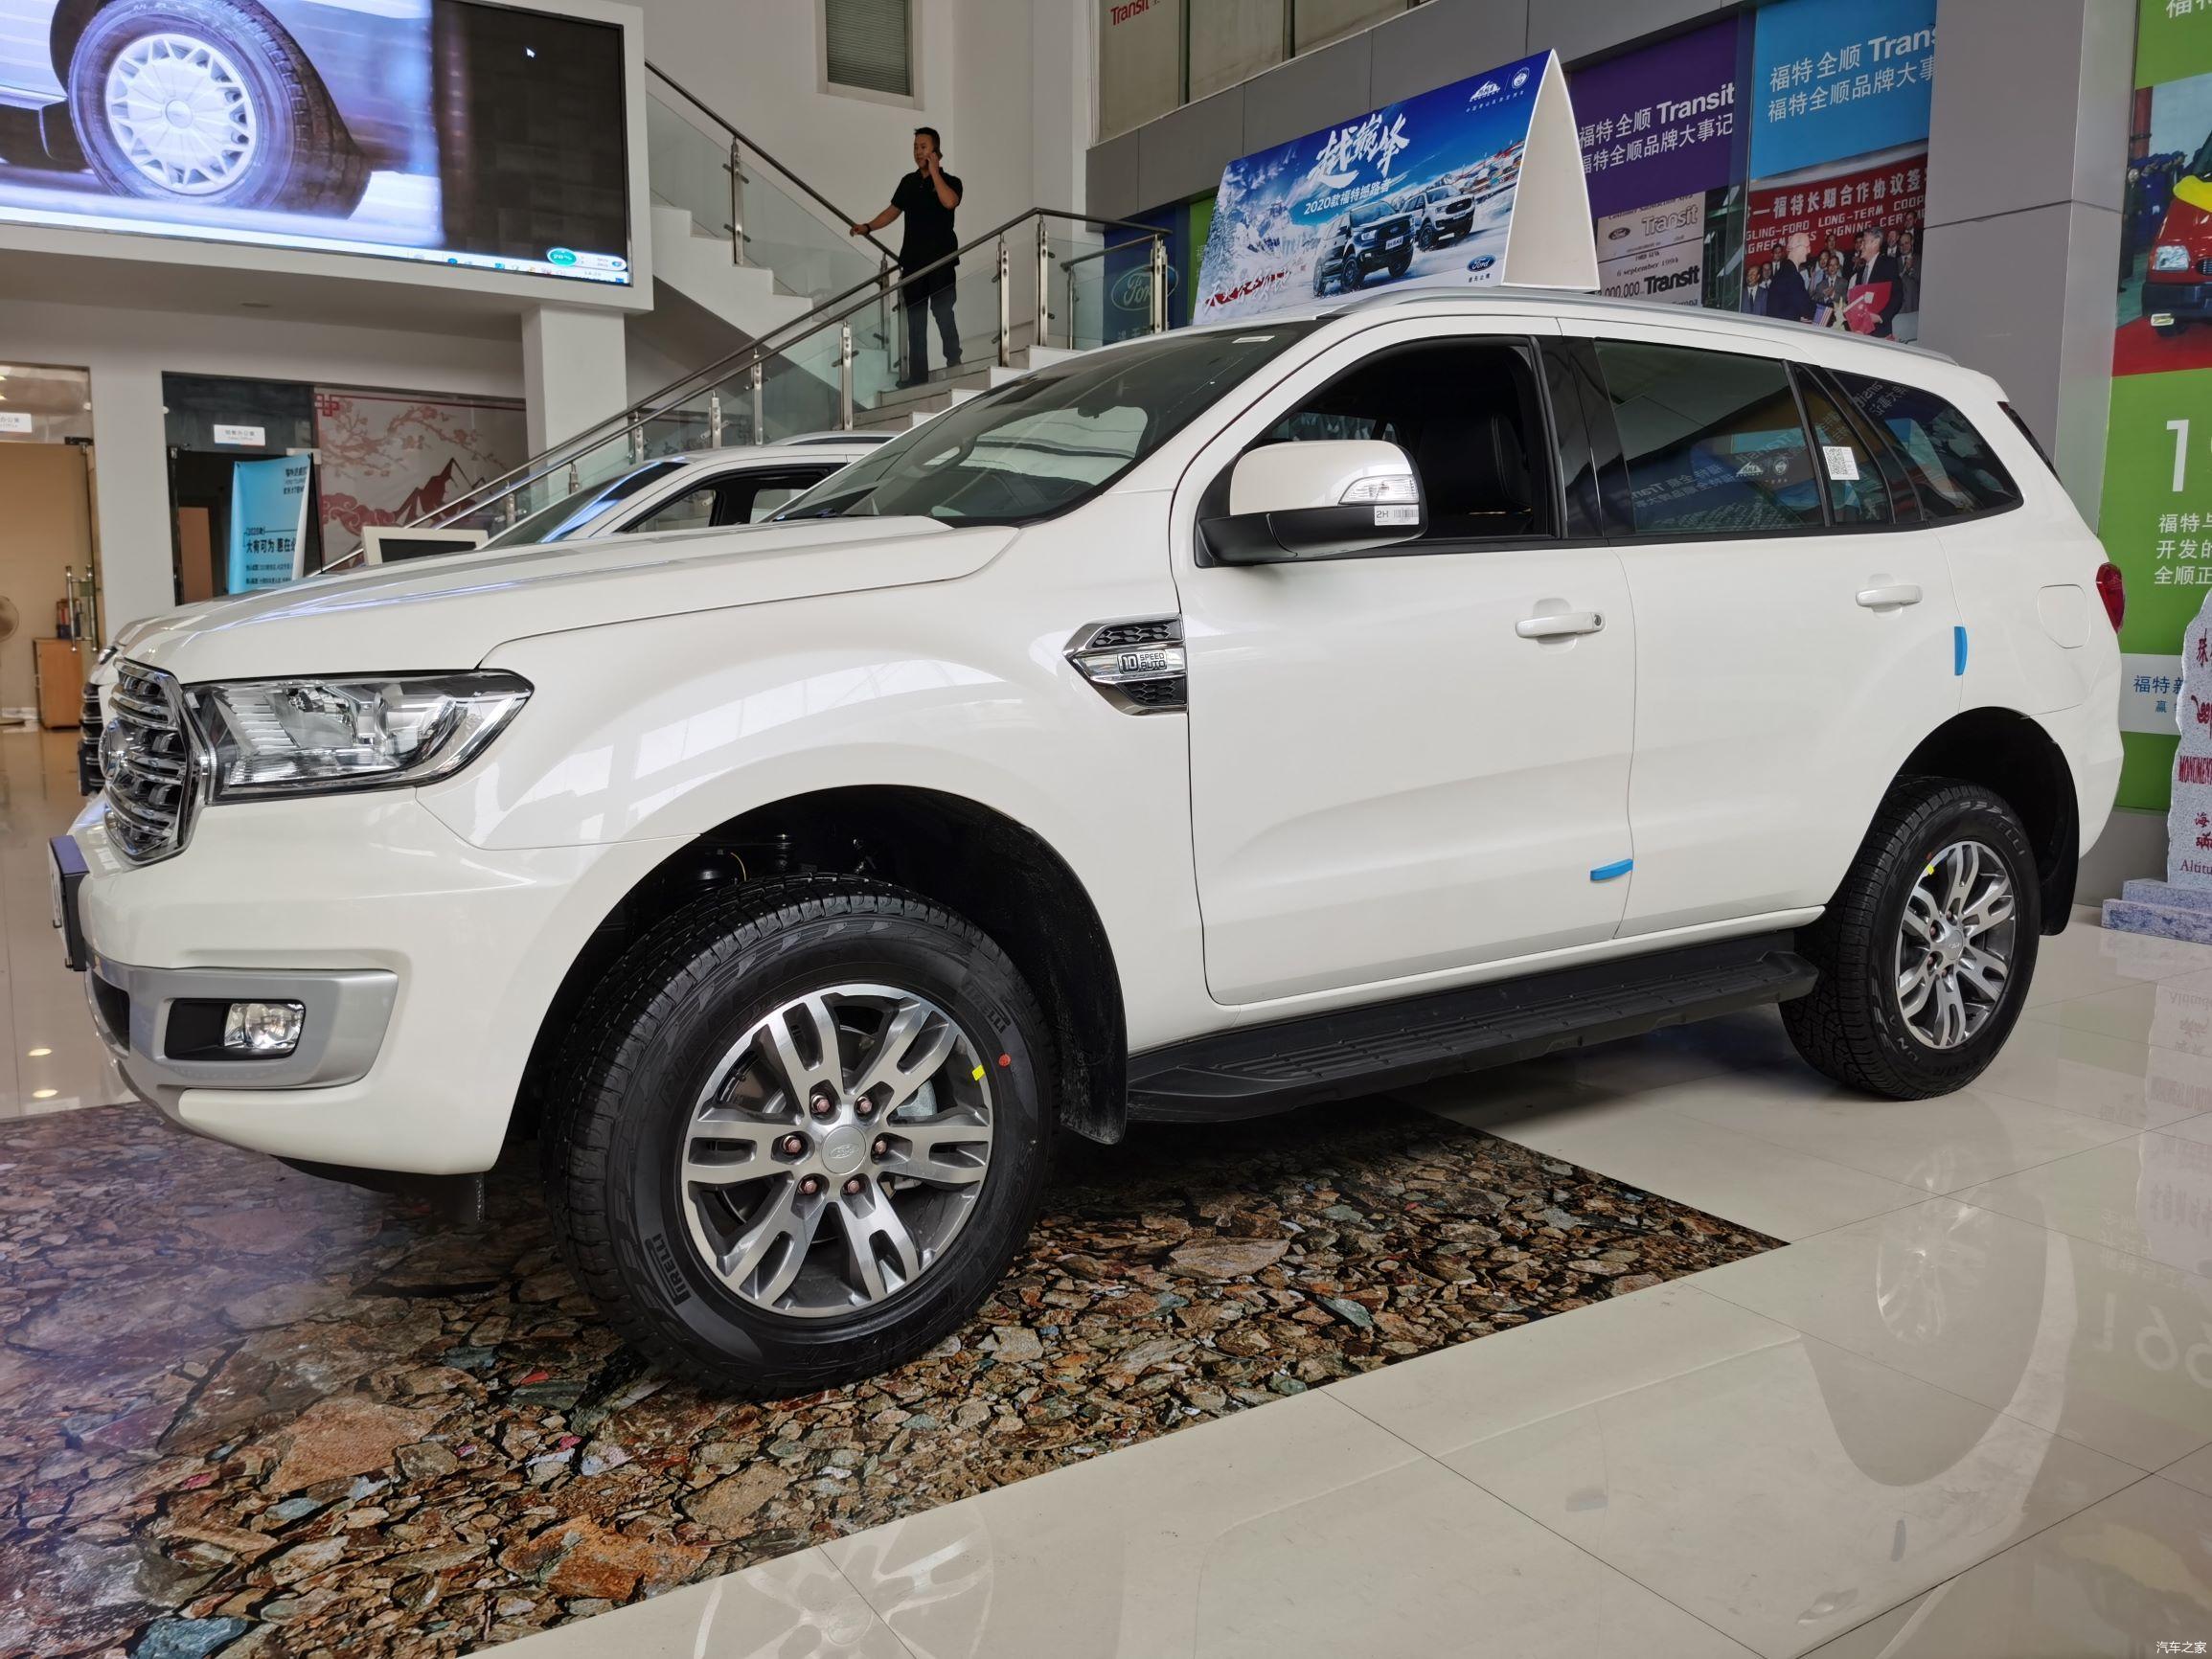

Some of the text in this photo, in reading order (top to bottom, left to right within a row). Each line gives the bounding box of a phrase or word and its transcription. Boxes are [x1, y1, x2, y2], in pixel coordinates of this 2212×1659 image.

[1770, 43, 1861, 93] 福特全顺
[1579, 82, 1735, 150] 福特全顺 Transit
[1641, 204, 1699, 237] Transit
[1644, 264, 1699, 295] Transit
[1140, 652, 1165, 661] SPEED
[1140, 660, 1167, 670] AUTO
[645, 1233, 692, 1307] PIRELLI
